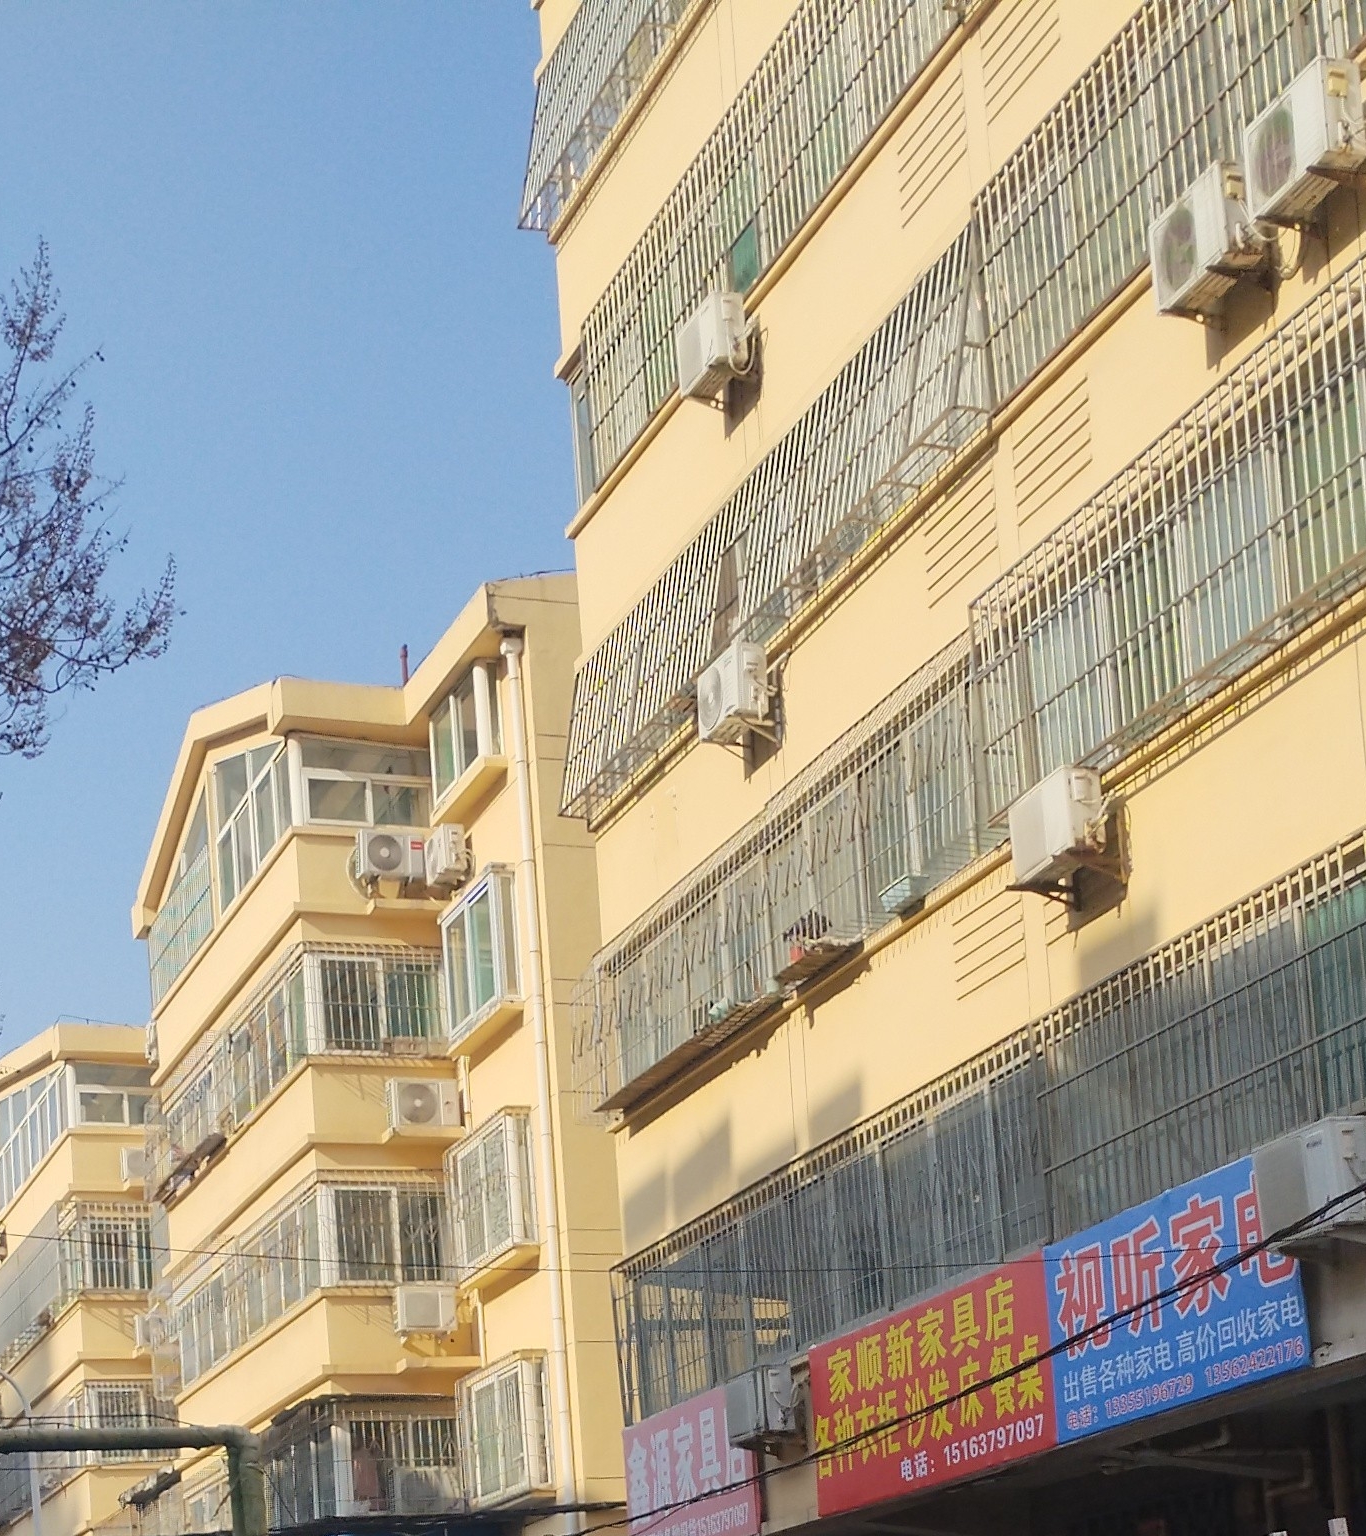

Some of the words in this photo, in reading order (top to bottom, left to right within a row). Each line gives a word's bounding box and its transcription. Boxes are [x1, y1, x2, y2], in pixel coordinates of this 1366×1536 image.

[826, 1276, 1015, 1405] 家顺新家具店
[943, 1412, 1045, 1467] 15163797097
